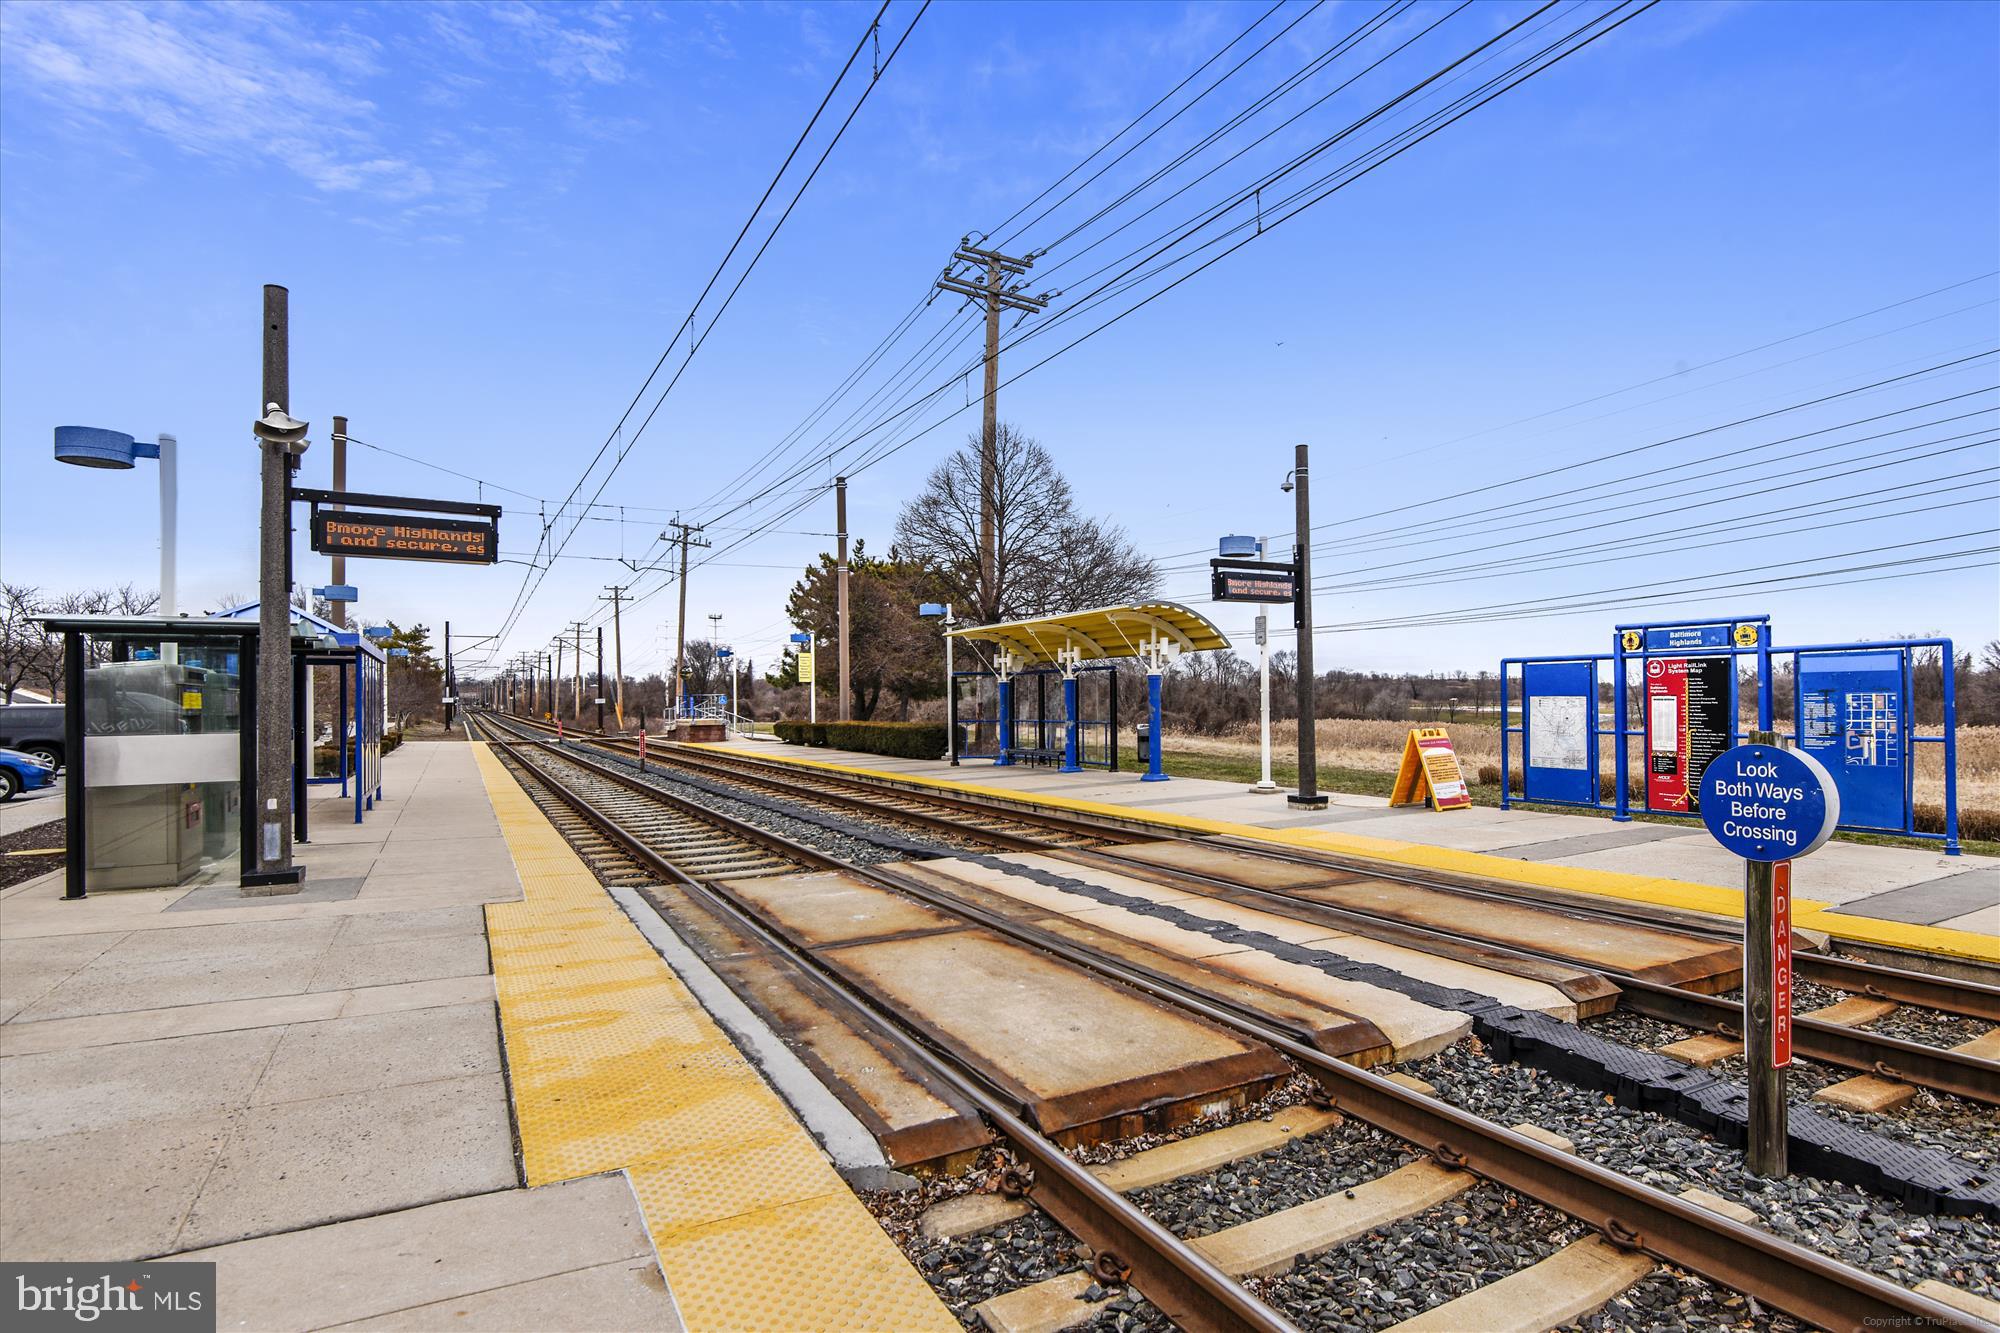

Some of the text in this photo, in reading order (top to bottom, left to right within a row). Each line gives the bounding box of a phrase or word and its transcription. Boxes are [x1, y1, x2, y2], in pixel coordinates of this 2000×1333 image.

[326, 521, 386, 537] Bmore
[340, 536, 378, 547] and
[386, 538, 460, 553] secure,
[466, 545, 485, 555] es
[1669, 638, 1702, 647] Highlands
[1670, 631, 1702, 639] Baltimore
[1737, 761, 1778, 778] Look
[1715, 780, 1804, 803] Both Ways
[1731, 801, 1786, 820] Before
[1723, 821, 1797, 846] Crossing
[1776, 895, 1788, 1034] DANGER
